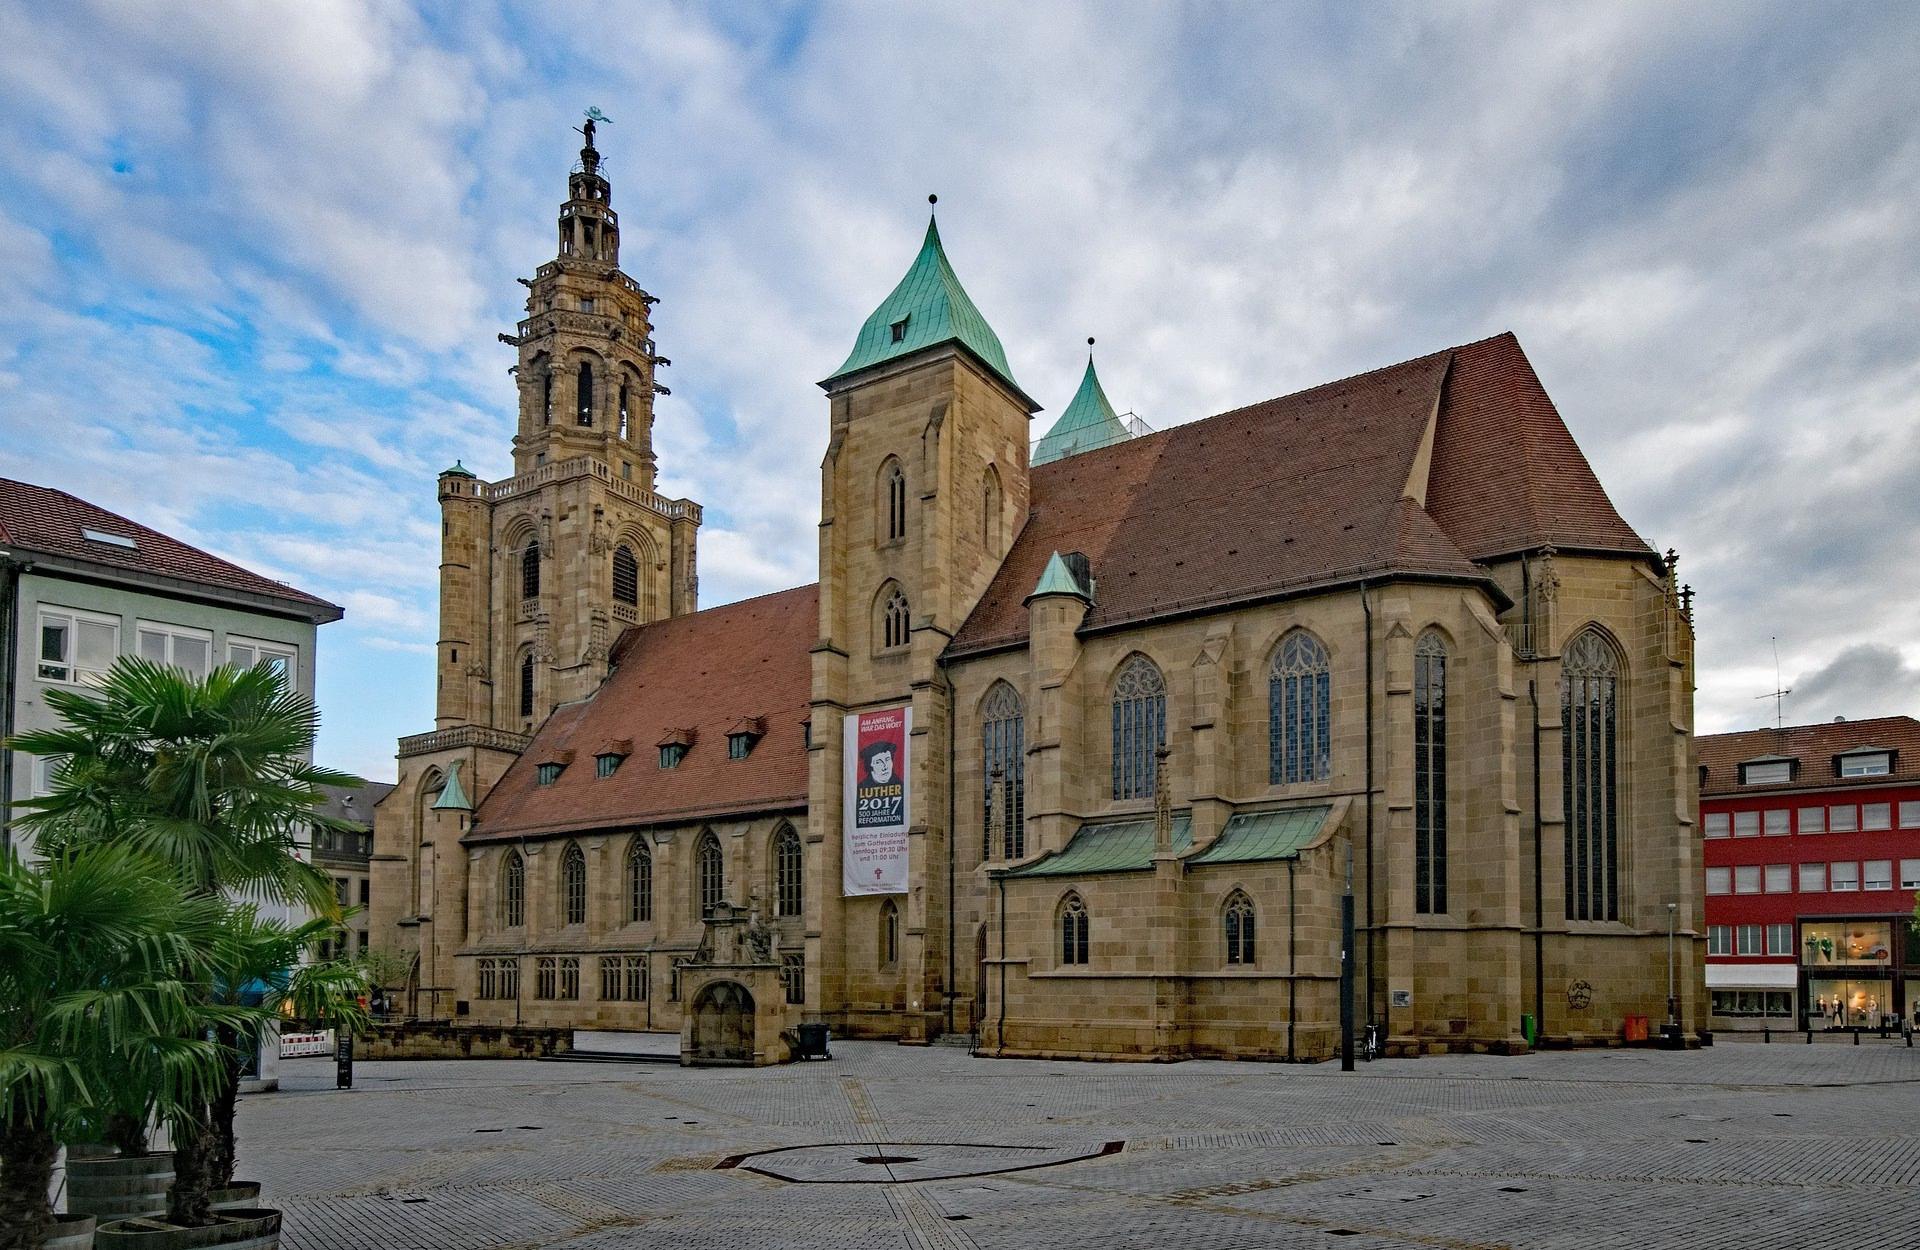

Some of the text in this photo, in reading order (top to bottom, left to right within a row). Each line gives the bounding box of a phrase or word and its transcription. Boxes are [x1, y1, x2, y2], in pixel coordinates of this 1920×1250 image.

[874, 723, 886, 731] DAS
[886, 721, 903, 729] WORT
[859, 784, 901, 798] LUTHER
[859, 796, 902, 815] 2017
[858, 815, 901, 824] REFORMATION
